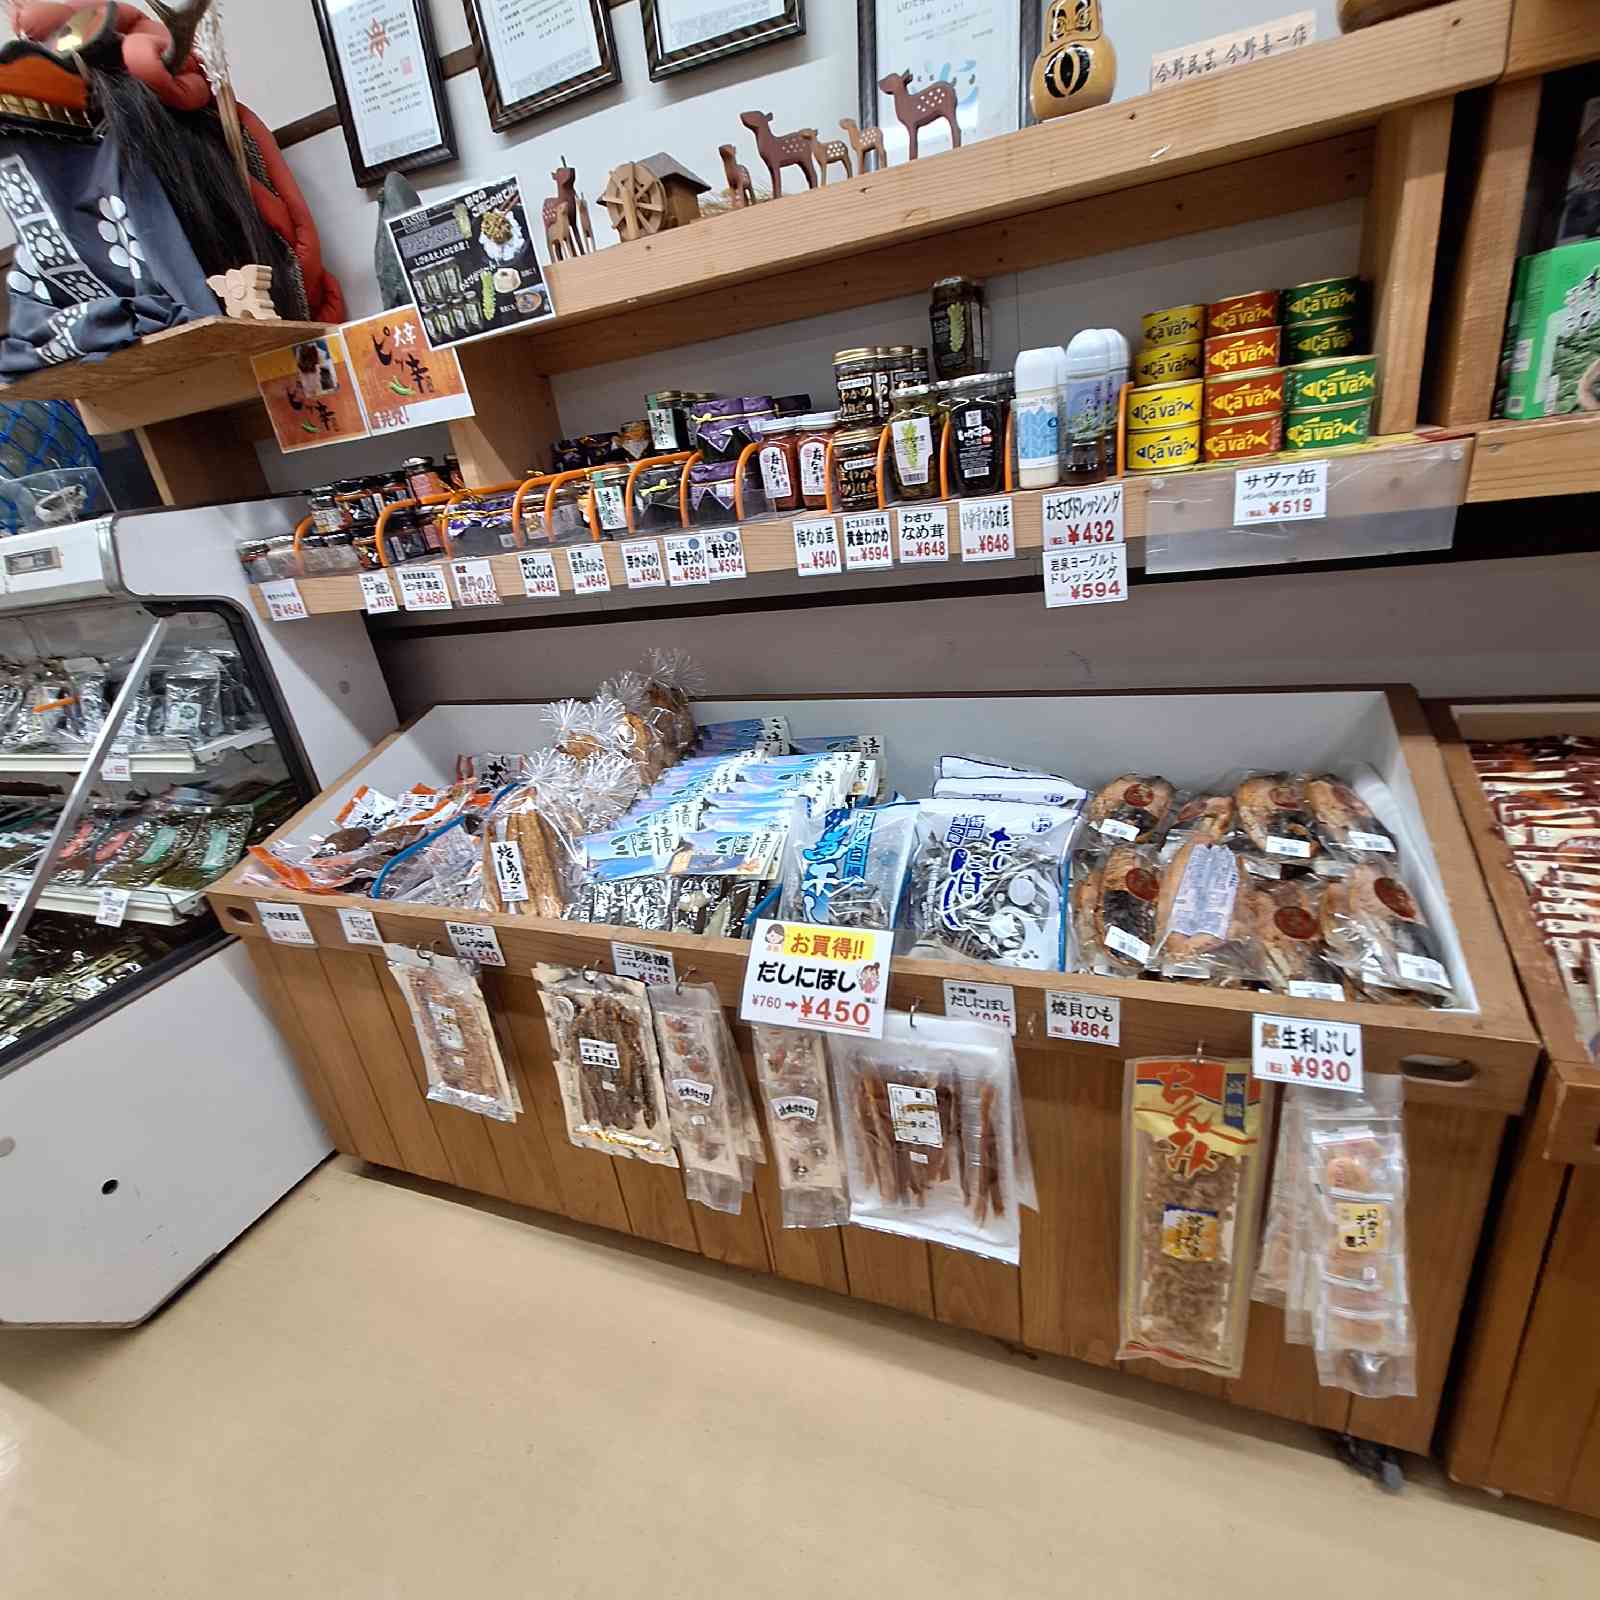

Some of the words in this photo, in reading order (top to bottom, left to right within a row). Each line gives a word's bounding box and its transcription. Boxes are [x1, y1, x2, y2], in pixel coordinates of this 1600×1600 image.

[1220, 349, 1238, 370] Ça
[1241, 342, 1265, 361] va?
[1315, 380, 1337, 403] Ça
[1339, 373, 1365, 393] va?
[1141, 405, 1157, 424] Ça
[1159, 399, 1184, 417] va?
[1223, 394, 1241, 416] Ça
[1244, 387, 1269, 406] va?
[1212, 437, 1229, 457] Ça
[1231, 431, 1255, 450] va?
[1296, 428, 1312, 448] Ça
[1313, 420, 1343, 438] va?
[1147, 444, 1164, 463] Ça
[1167, 438, 1190, 456] va?
[1243, 469, 1316, 490] サヴァ缶
[904, 512, 933, 523] わさび
[1046, 492, 1120, 521] わさびドレッシング
[1268, 498, 1312, 515] ¥519
[901, 524, 944, 541] なめ茸
[979, 534, 1009, 552] ¥648
[1067, 520, 1114, 545] ¥432
[812, 550, 837, 569] ¥540
[861, 546, 888, 562] ¥594
[916, 541, 945, 557] ¥648
[718, 558, 743, 573] ¥594
[1050, 551, 1118, 571] 岩泉ヨーグルト
[1050, 566, 1117, 584] ドレッシング
[1070, 580, 1121, 600] ¥594
[790, 933, 865, 961] お買得!!
[751, 994, 781, 1009] ¥760
[800, 994, 870, 1026] ¥450
[1051, 1001, 1114, 1023] 焼貝ひも
[1070, 1020, 1110, 1040] ¥864
[1281, 1025, 1356, 1056] 生利ぶし
[1290, 1055, 1351, 1082] ¥930
